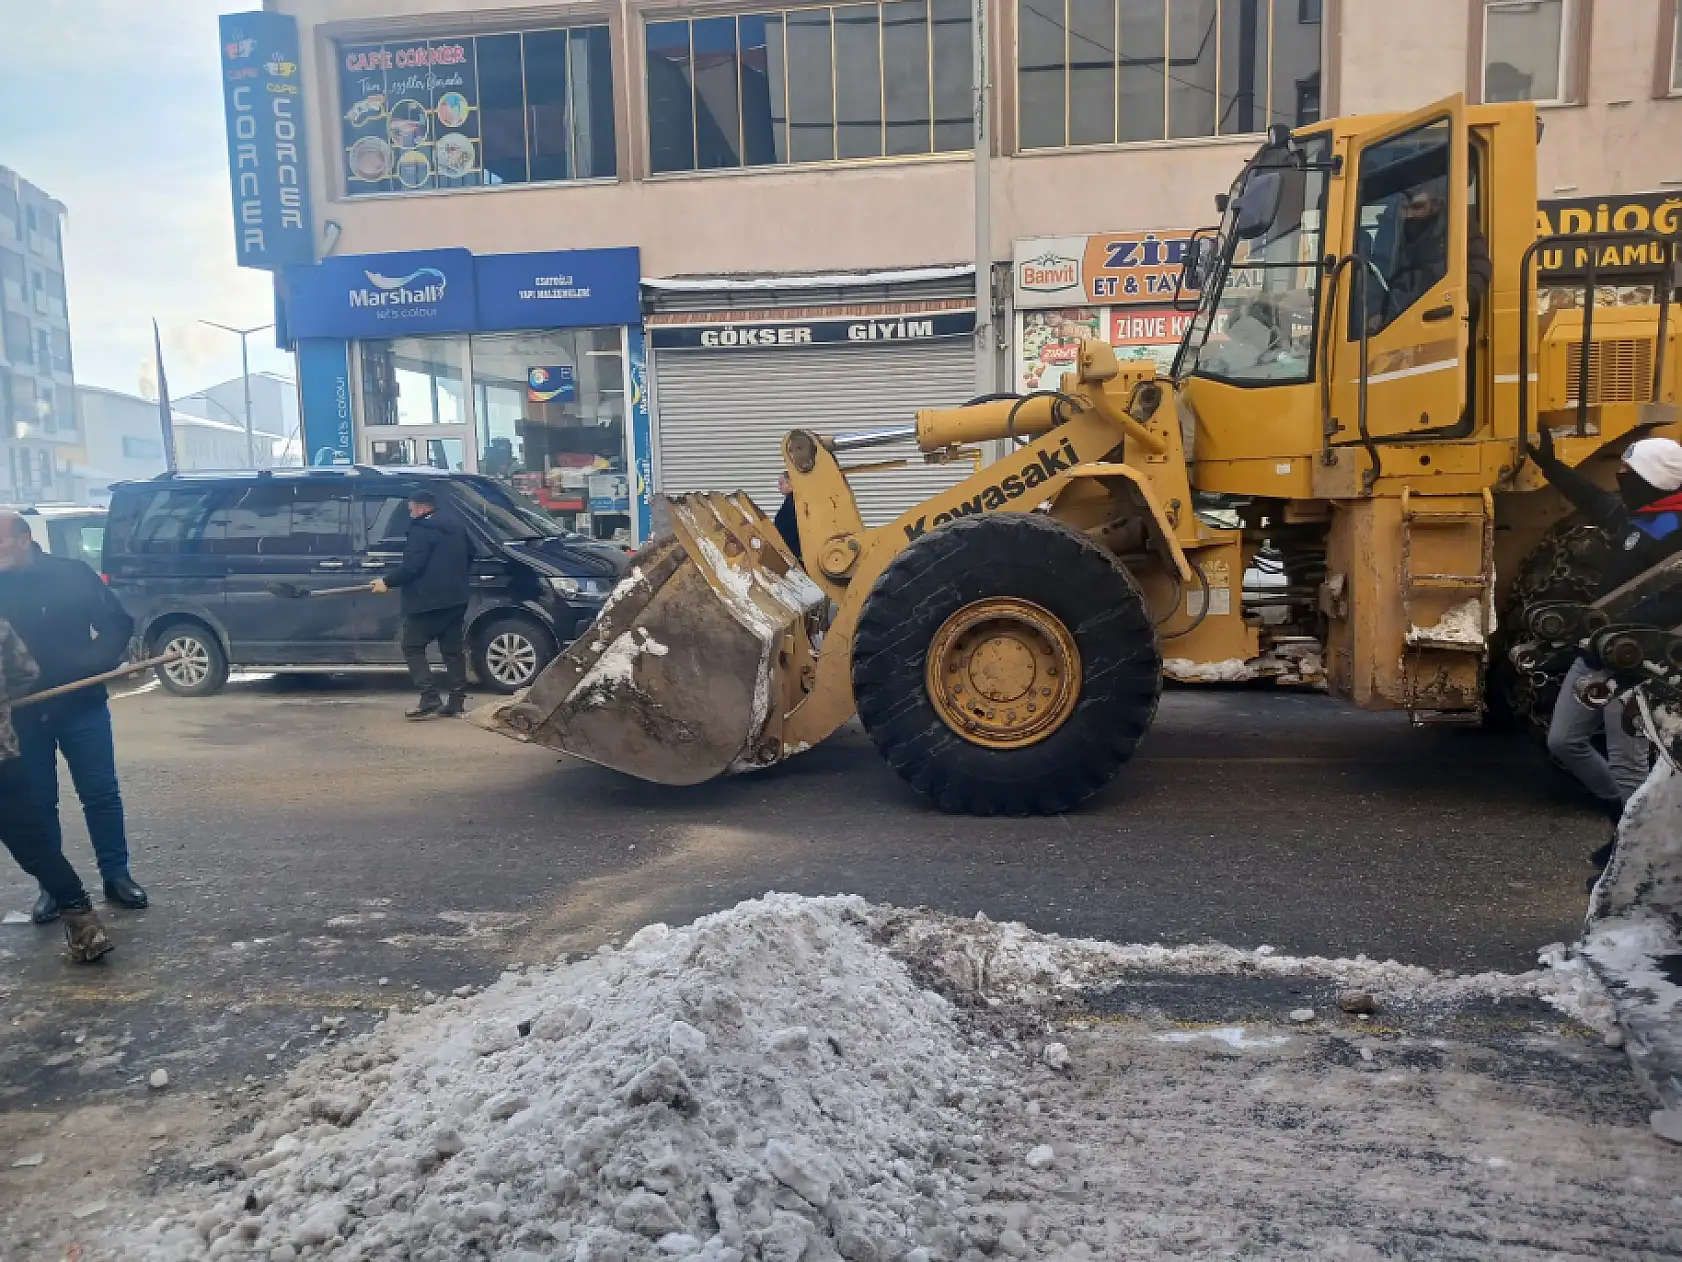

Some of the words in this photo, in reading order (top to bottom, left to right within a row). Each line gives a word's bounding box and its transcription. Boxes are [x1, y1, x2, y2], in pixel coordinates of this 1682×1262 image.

[1024, 264, 1074, 285] Banvit
[1093, 276, 1118, 296] ET
[1123, 275, 1139, 295] &
[349, 284, 438, 308] Marshall
[700, 325, 812, 348] GÖKSER
[848, 318, 934, 340] GİYİM
[1116, 312, 1166, 340] ZİRVE
[903, 437, 1080, 542] Kawasaki
